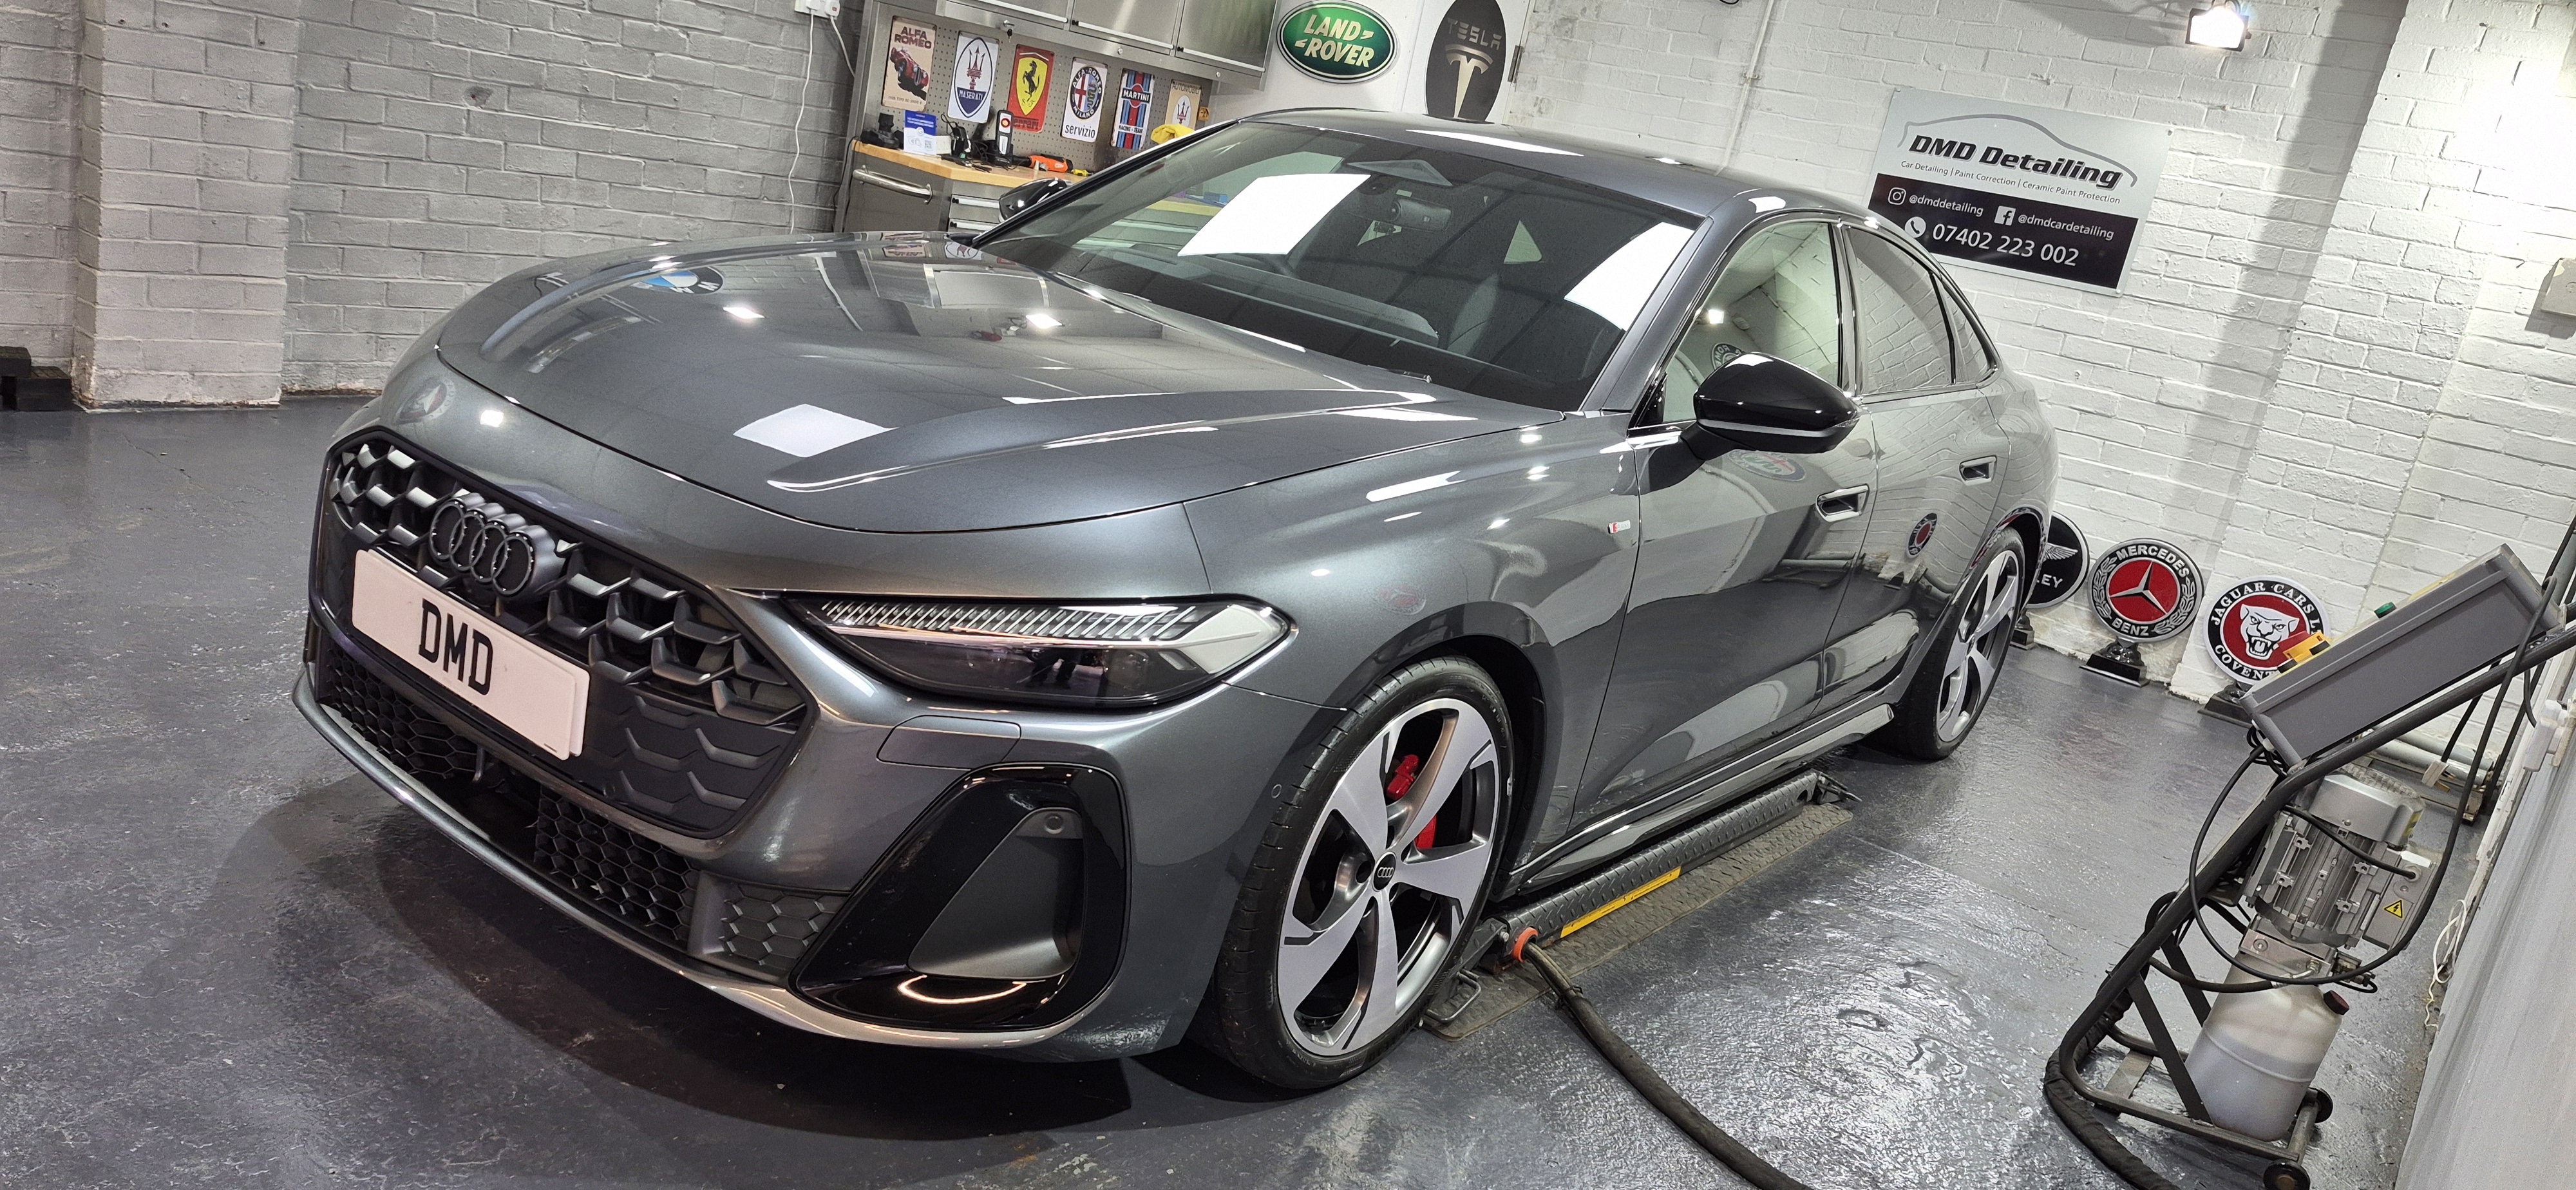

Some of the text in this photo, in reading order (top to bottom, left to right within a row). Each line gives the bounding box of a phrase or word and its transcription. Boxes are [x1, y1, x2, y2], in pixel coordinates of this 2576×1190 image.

[900, 26, 927, 40] ALFA
[1303, 14, 1361, 41] LAND
[1446, 17, 1502, 50] TESLA
[894, 33, 932, 49] ROMEO
[1304, 37, 1374, 68] ROVER
[958, 90, 983, 101] MASERATI
[1122, 89, 1150, 102] MARTINI
[1013, 117, 1039, 130] errari
[1073, 106, 1094, 118] MILANO
[1065, 124, 1095, 138] servizio
[1909, 135, 2123, 191] DMD Detailing
[1915, 162, 1949, 176] Detailing
[1955, 169, 1975, 179] Paint
[1976, 173, 2016, 186] Correction
[2022, 181, 2054, 193] Ceramic
[2055, 186, 2076, 196] Paint
[2078, 190, 2121, 204] Protection
[1909, 194, 1984, 217] @dmddetailing
[2018, 214, 2114, 241] @dmdcardetailing
[1933, 223, 2079, 267] 07402 223 002
[2116, 545, 2190, 578] MERCEDES
[2036, 574, 2063, 589] EY
[2211, 581, 2266, 626] JAGUAR
[2273, 583, 2315, 614] CARS
[2112, 617, 2149, 636] BENZ
[419, 598, 493, 695] DMD
